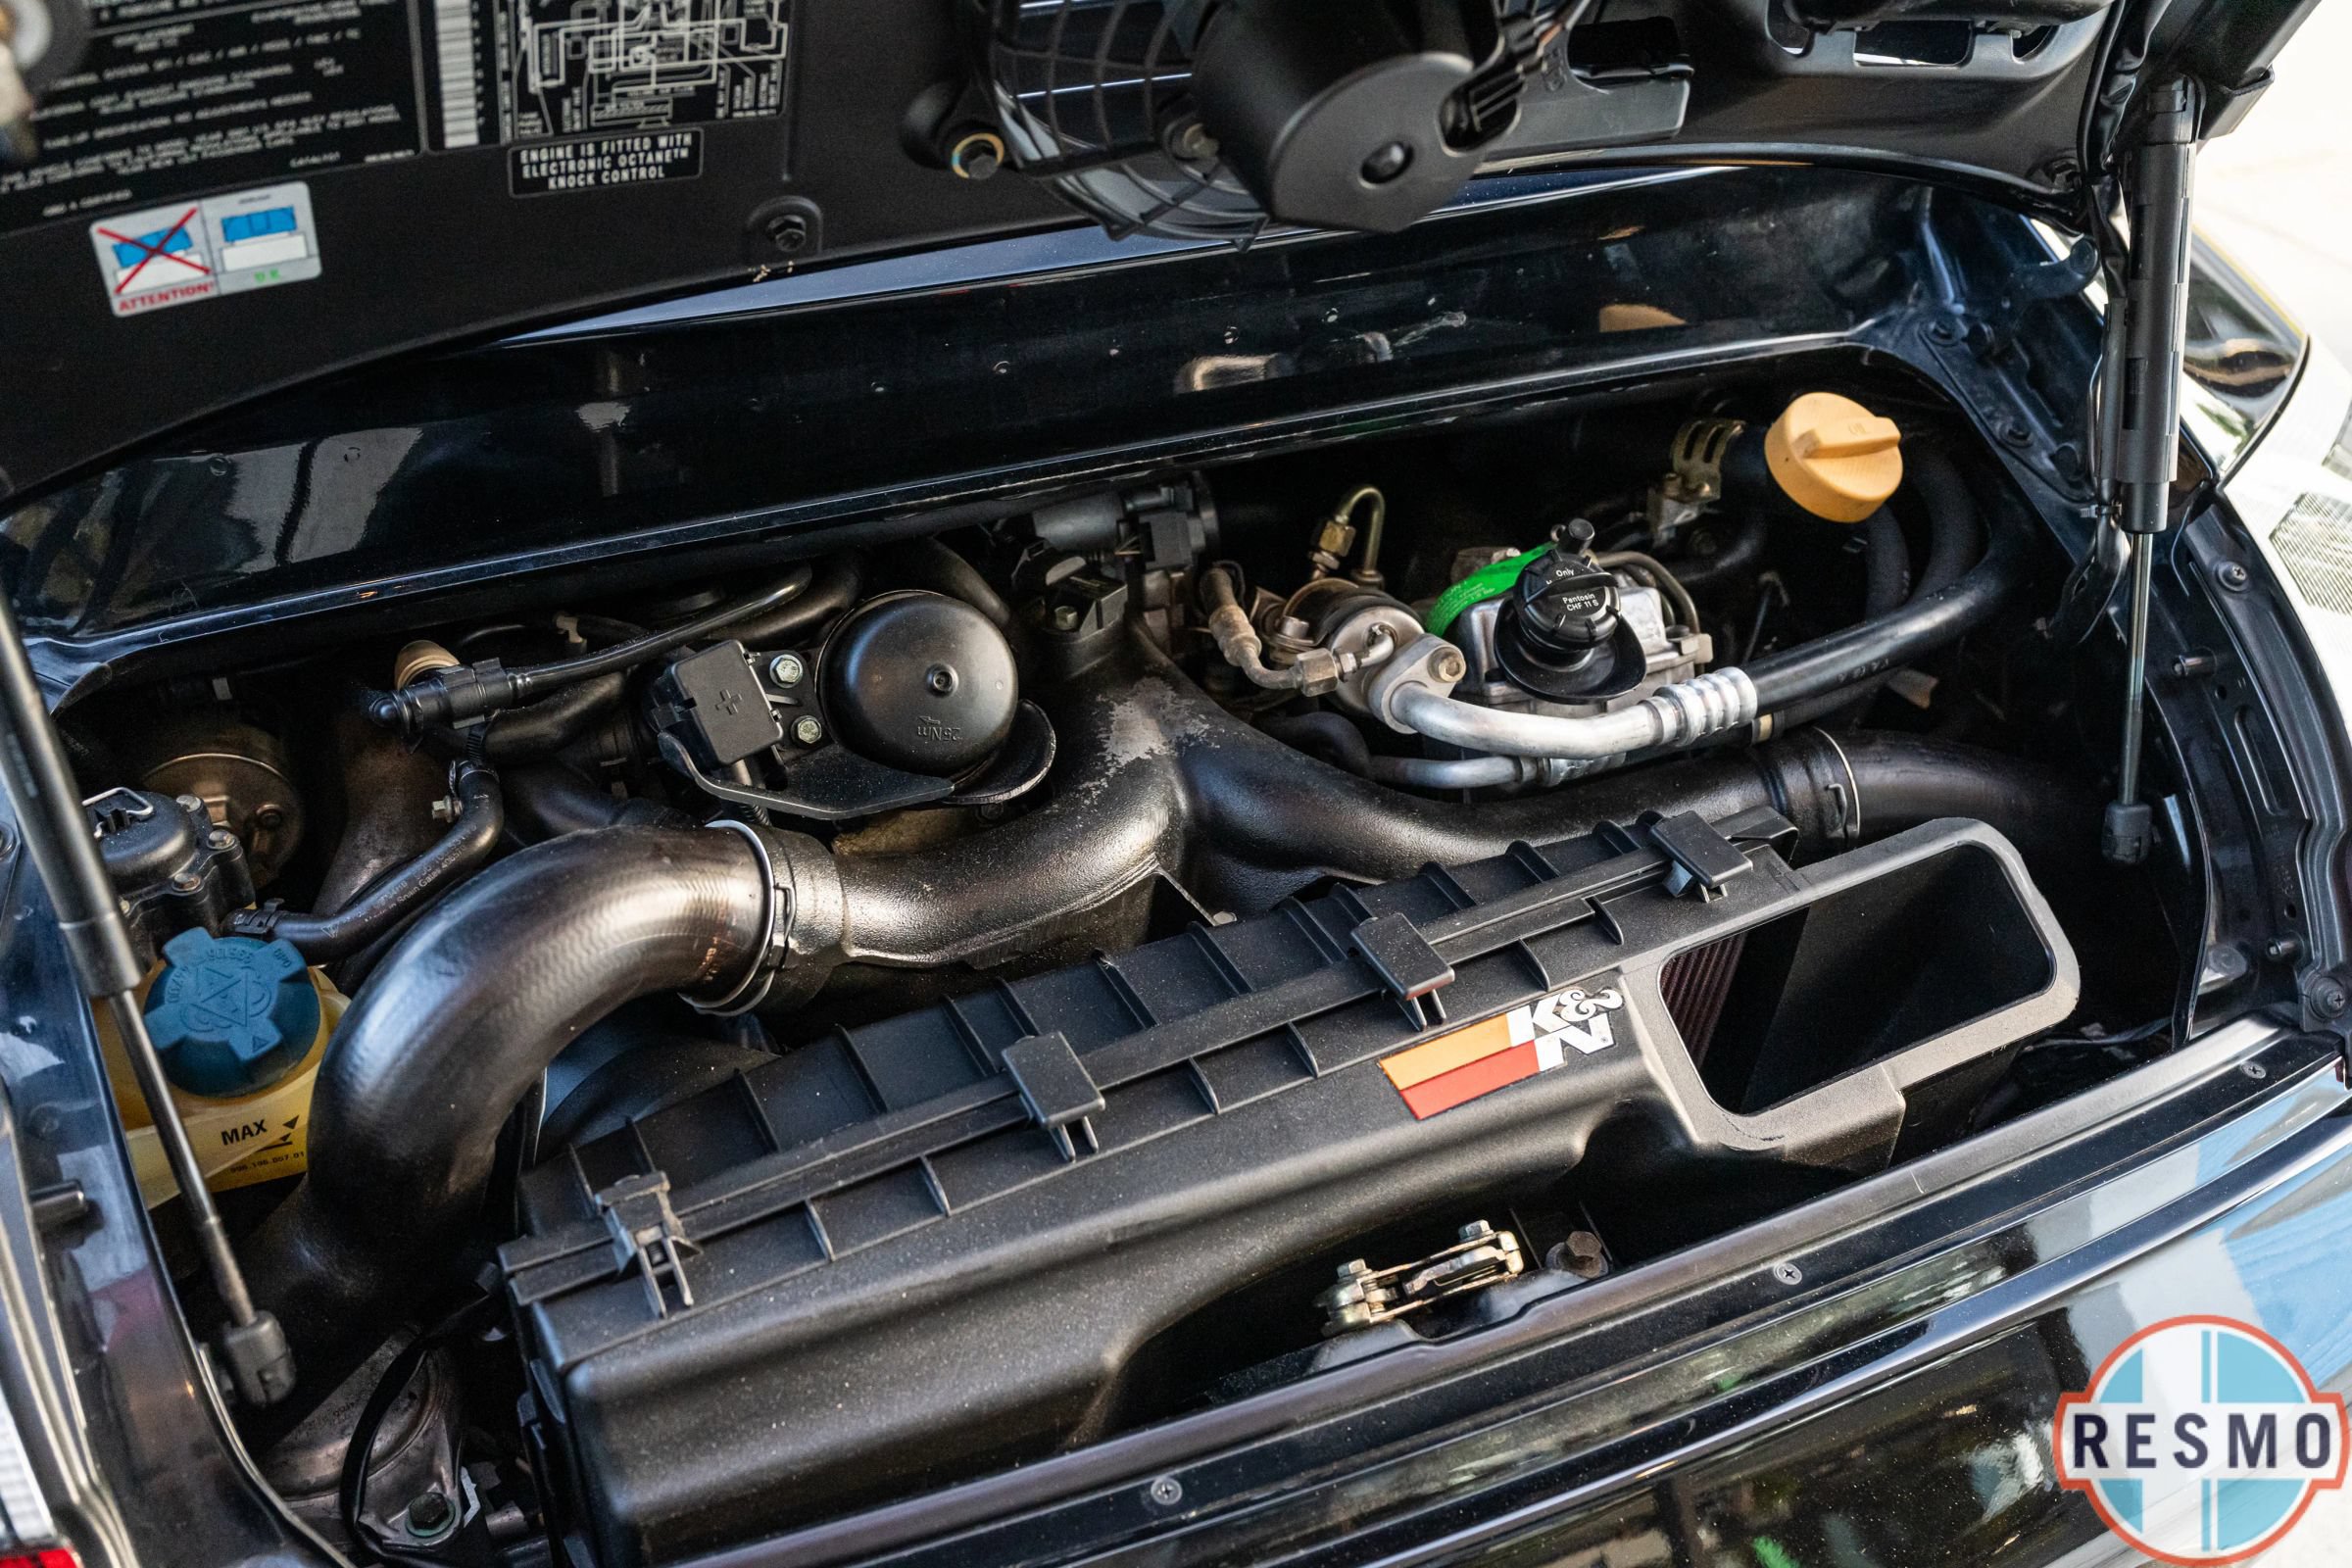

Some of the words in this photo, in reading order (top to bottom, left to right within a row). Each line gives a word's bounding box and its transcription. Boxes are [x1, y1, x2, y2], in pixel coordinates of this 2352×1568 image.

[520, 145, 574, 165] ENGINE
[580, 143, 596, 157] IS
[601, 137, 652, 155] FITTED
[658, 133, 692, 149] WITH
[522, 155, 612, 179] ELECTRONIC
[548, 172, 596, 190] KNOCK
[601, 165, 665, 184] CONTROL
[1555, 567, 1575, 578] Only
[1562, 592, 1596, 605] Pentosin
[1566, 602, 1583, 612] CHF
[1583, 600, 1592, 610] 11
[1592, 599, 1599, 608] S
[220, 1119, 268, 1146] MAX
